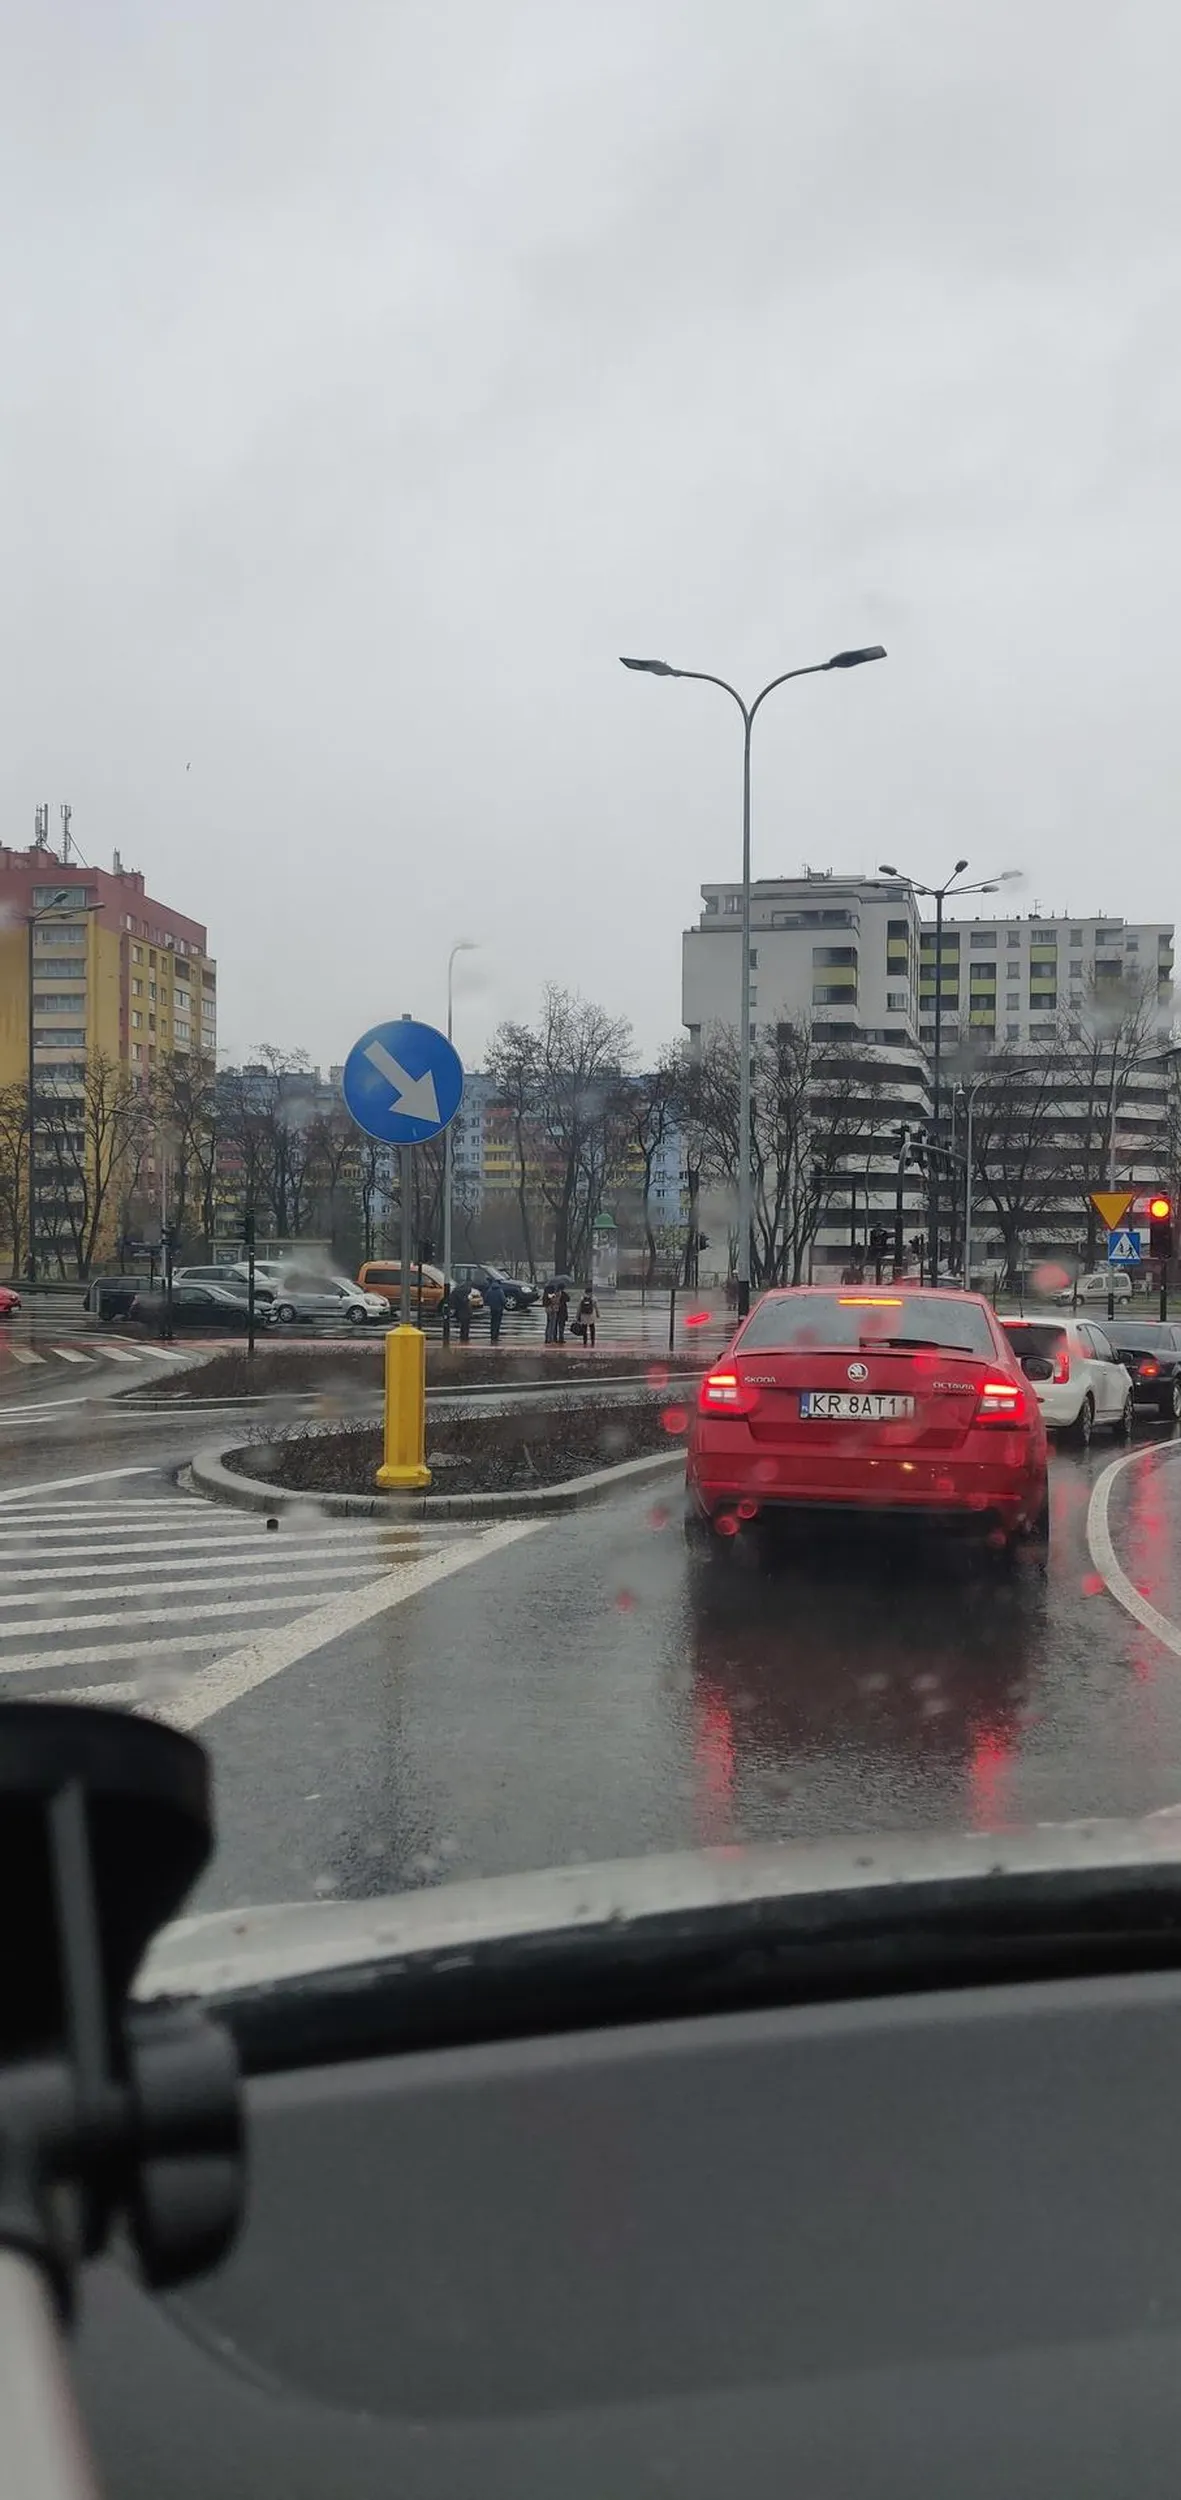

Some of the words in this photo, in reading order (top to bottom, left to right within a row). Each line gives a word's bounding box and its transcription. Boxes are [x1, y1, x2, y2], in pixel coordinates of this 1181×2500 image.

[932, 1381, 975, 1391] OCTAVIA
[812, 1394, 841, 1414] KR
[848, 1396, 909, 1416] 8AT11
